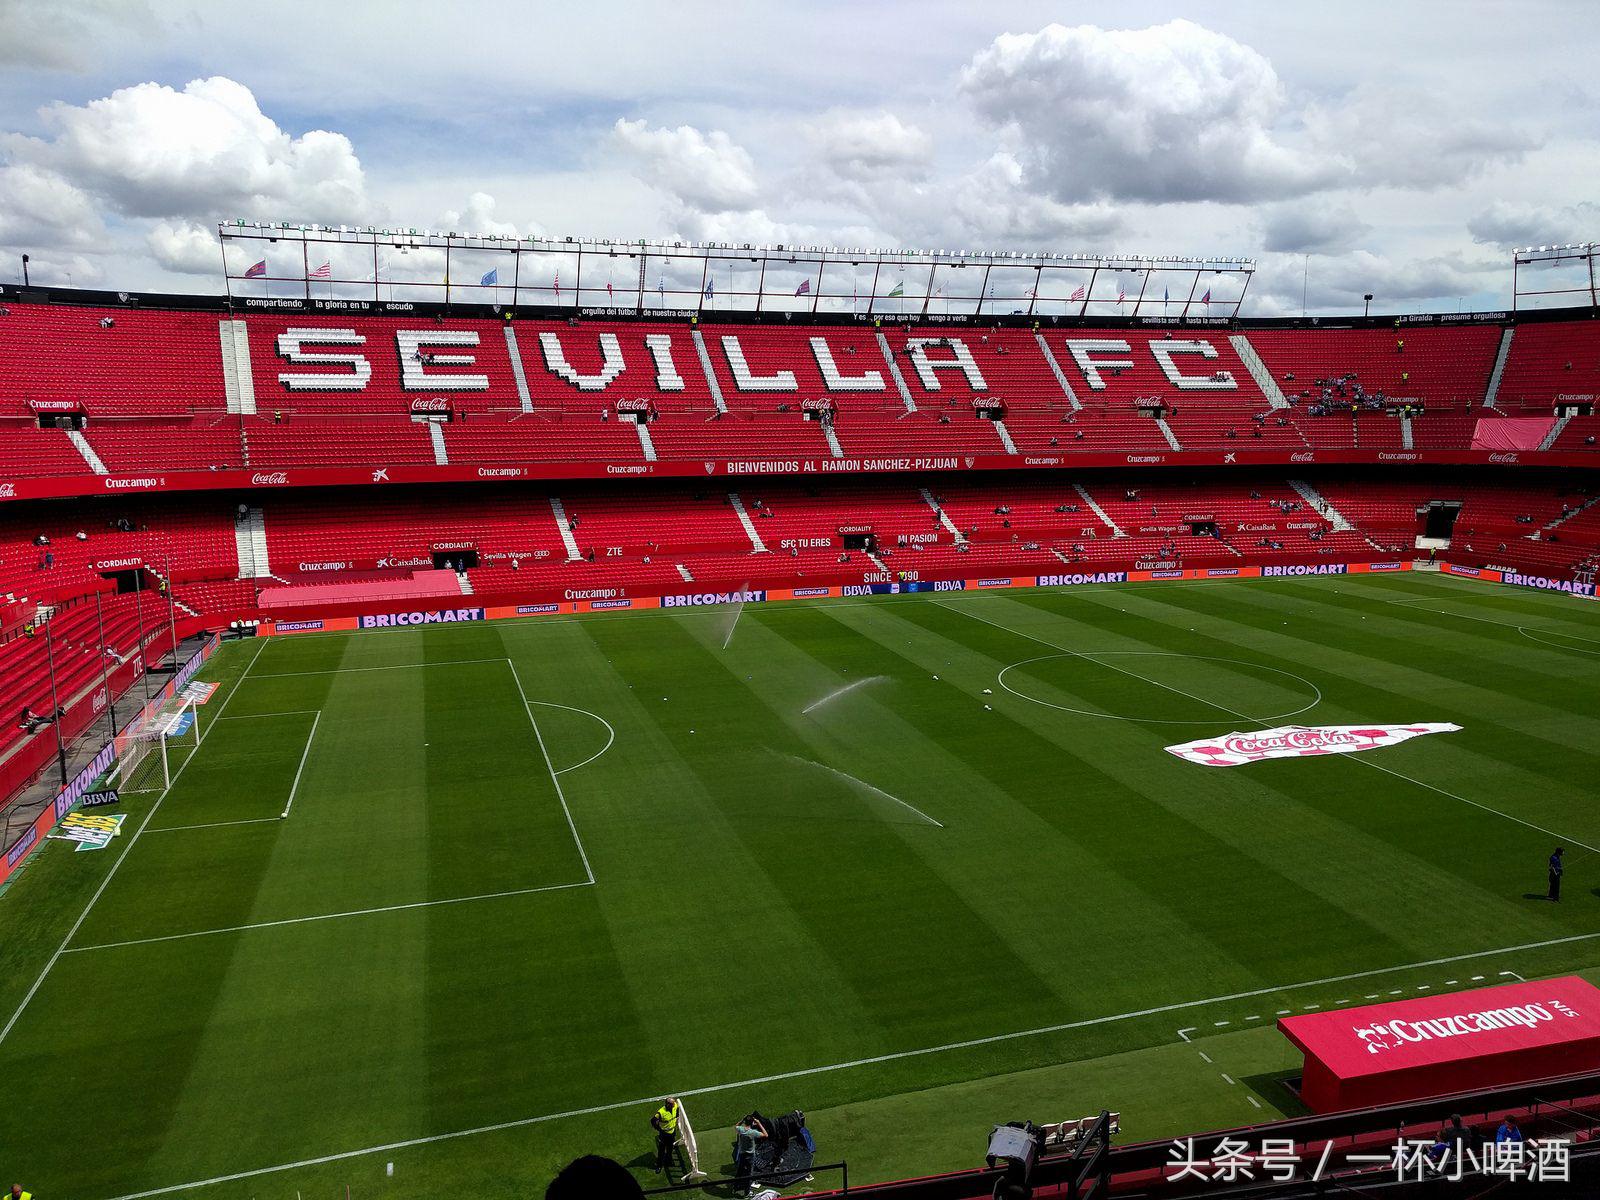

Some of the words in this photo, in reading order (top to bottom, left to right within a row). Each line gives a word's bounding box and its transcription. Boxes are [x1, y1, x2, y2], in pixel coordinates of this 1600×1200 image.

[246, 298, 303, 309] compartiendo
[315, 299, 324, 308] la
[325, 299, 348, 310] gloria
[350, 301, 360, 309] en
[361, 300, 370, 309] tu
[386, 302, 414, 311] escudo
[582, 307, 606, 316] orgullo
[607, 307, 617, 315] del
[643, 308, 652, 316] de
[652, 309, 677, 317] nuestra
[1408, 314, 1433, 322] Giralda
[276, 327, 988, 392] SEVILLA
[1065, 338, 1238, 391] FC
[30, 399, 74, 409] Cruzcampo
[1024, 456, 1059, 466] Cruzcampo
[1127, 454, 1160, 464] Cruzcampo
[1378, 451, 1416, 461] Cruzcampo
[606, 464, 647, 474] Cruzcampo
[727, 461, 799, 474] BIENVENIDOS
[803, 461, 817, 472] AL
[822, 459, 861, 472] RAMON
[863, 457, 958, 471] SANCHEZ-PIZJUAN
[478, 467, 521, 477] Cruzcampo
[105, 478, 157, 489] Cruzcampo
[838, 525, 872, 533] CORDIALITY
[1246, 523, 1277, 532] CaixaBank
[1286, 521, 1317, 530] Cruzcampo
[780, 538, 797, 549] SFC
[798, 538, 809, 548] TU
[810, 537, 831, 548] ERES
[897, 534, 908, 544] MI
[909, 533, 938, 544] PASION
[433, 541, 474, 550] CORDIALITY
[483, 552, 507, 560] Sevilla
[507, 551, 532, 560] Wagen
[606, 546, 623, 557] ZTE
[96, 556, 142, 569] CORDIALITY
[299, 561, 346, 571] Cruzcampo
[389, 556, 433, 567] CaixaBank
[1135, 560, 1176, 570] Cruzcampo
[1263, 564, 1345, 577] BRICOMART
[863, 571, 892, 583] SINCE
[1039, 571, 1124, 587] BRICOMART
[1572, 570, 1596, 585] ZTE
[934, 580, 963, 592] BBVA
[1503, 572, 1592, 595] BRICOMART
[564, 588, 617, 600] Cruzcampo
[844, 585, 873, 597] BBVA
[664, 590, 763, 607] BRICOMART
[518, 604, 558, 614] BRICOMART
[592, 600, 631, 609] BRICOMART
[363, 608, 480, 628] BRICOMART
[276, 621, 323, 631] BRICOMART
[57, 742, 114, 819] BRICOMART
[82, 791, 119, 806] BBVA
[1388, 1003, 1554, 1042] Cruzcampo
